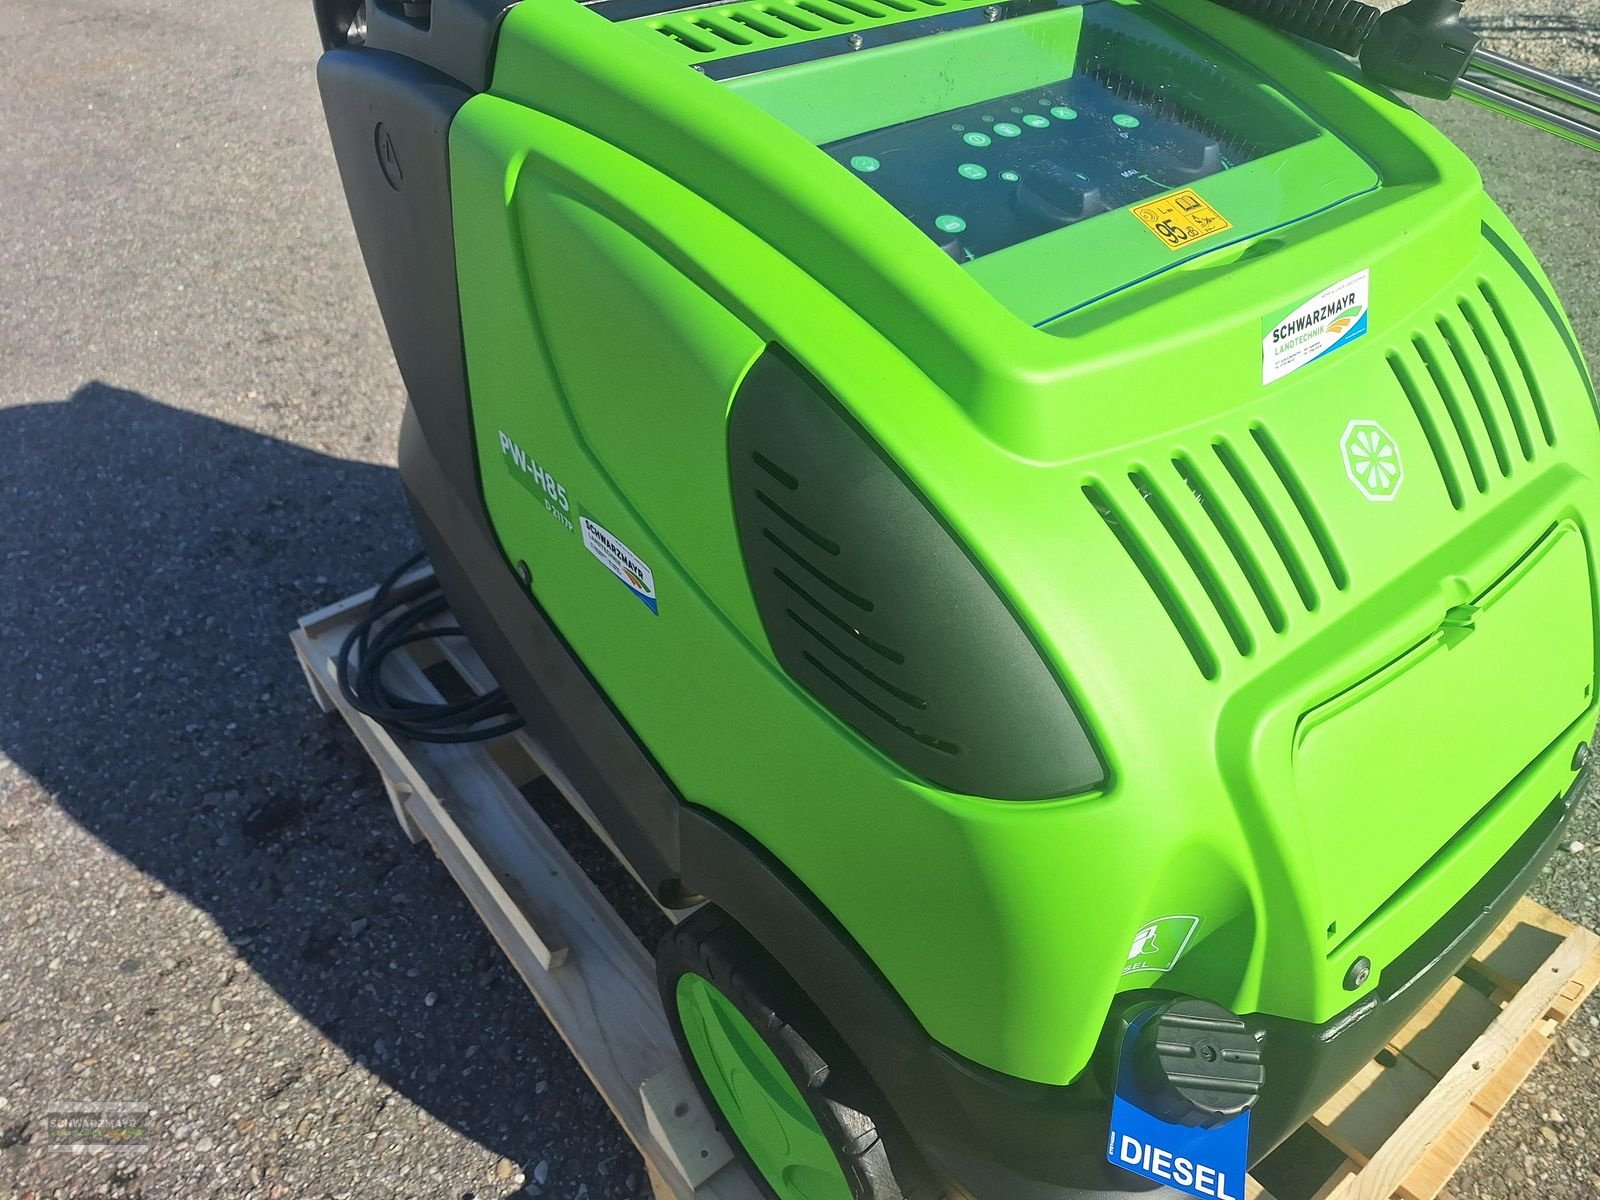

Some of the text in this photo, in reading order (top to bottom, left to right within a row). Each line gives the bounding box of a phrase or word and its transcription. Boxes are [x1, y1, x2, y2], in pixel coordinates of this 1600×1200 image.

[1155, 218, 1188, 244] 95
[1185, 226, 1199, 238] dB
[1273, 292, 1356, 343] SCHWARZMAYR
[1275, 325, 1325, 356] LANDTECHNIK
[498, 430, 570, 512] PW-H85
[585, 520, 644, 580] SCHWARZMAYR
[1120, 1134, 1237, 1200] DIESEL
